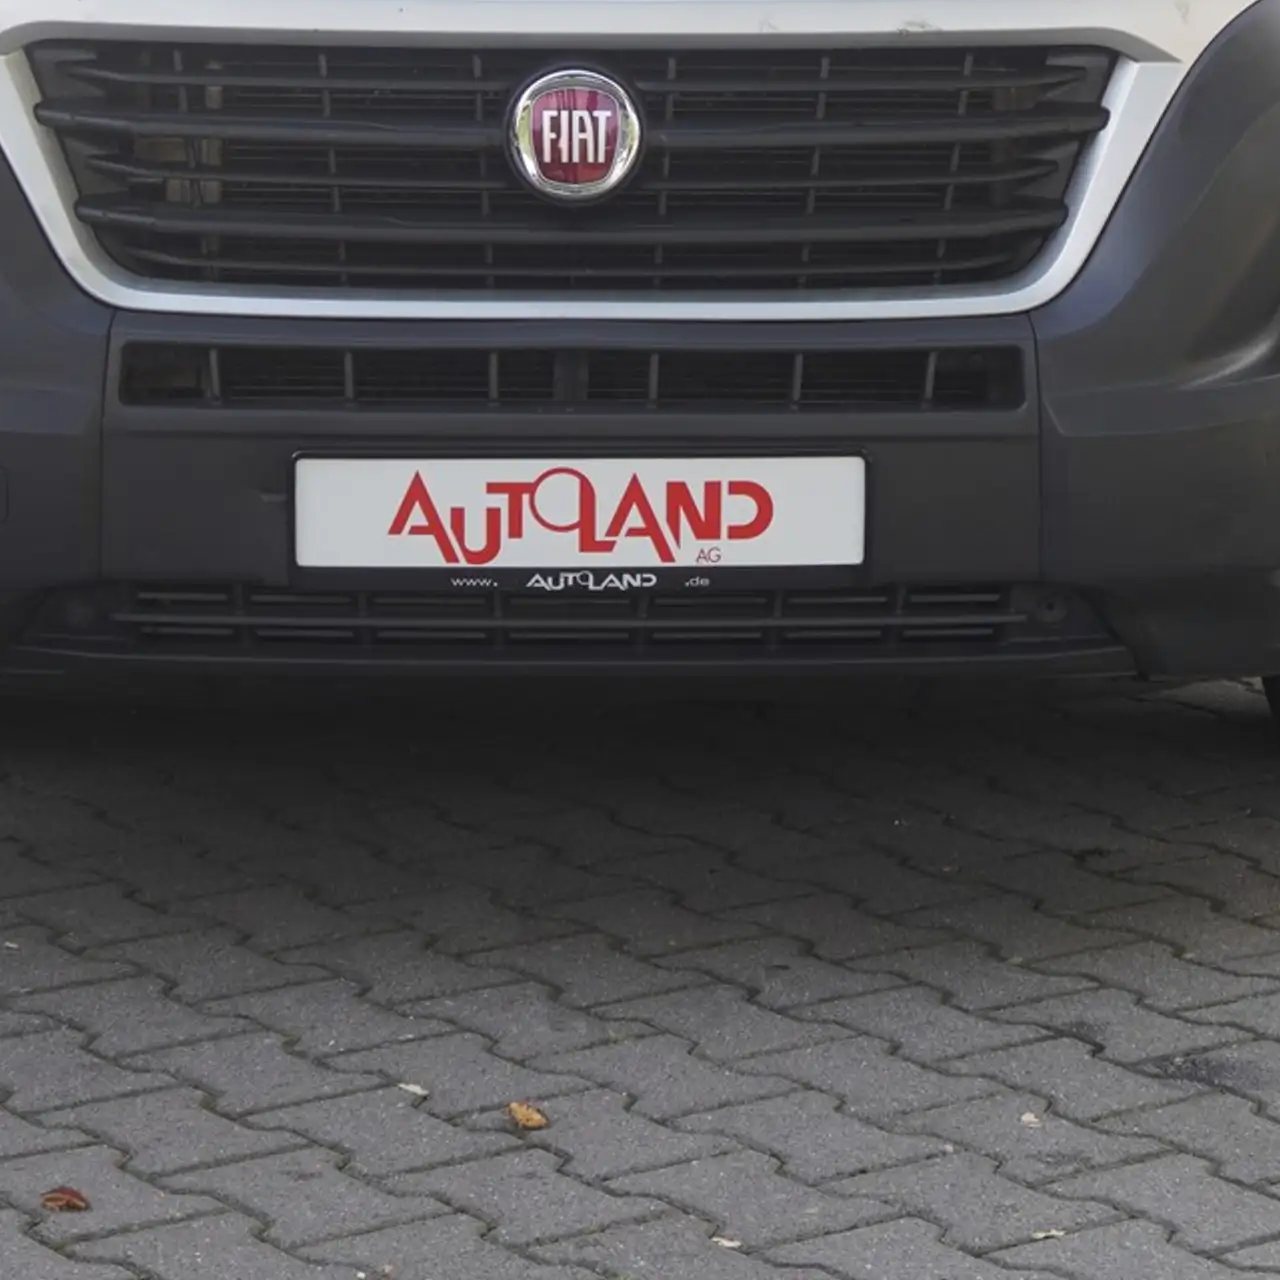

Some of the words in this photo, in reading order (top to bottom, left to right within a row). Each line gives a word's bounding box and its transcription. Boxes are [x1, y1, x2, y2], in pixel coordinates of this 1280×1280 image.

[542, 110, 612, 163] FIAT
[695, 546, 722, 563] AG
[451, 578, 498, 587] www.
